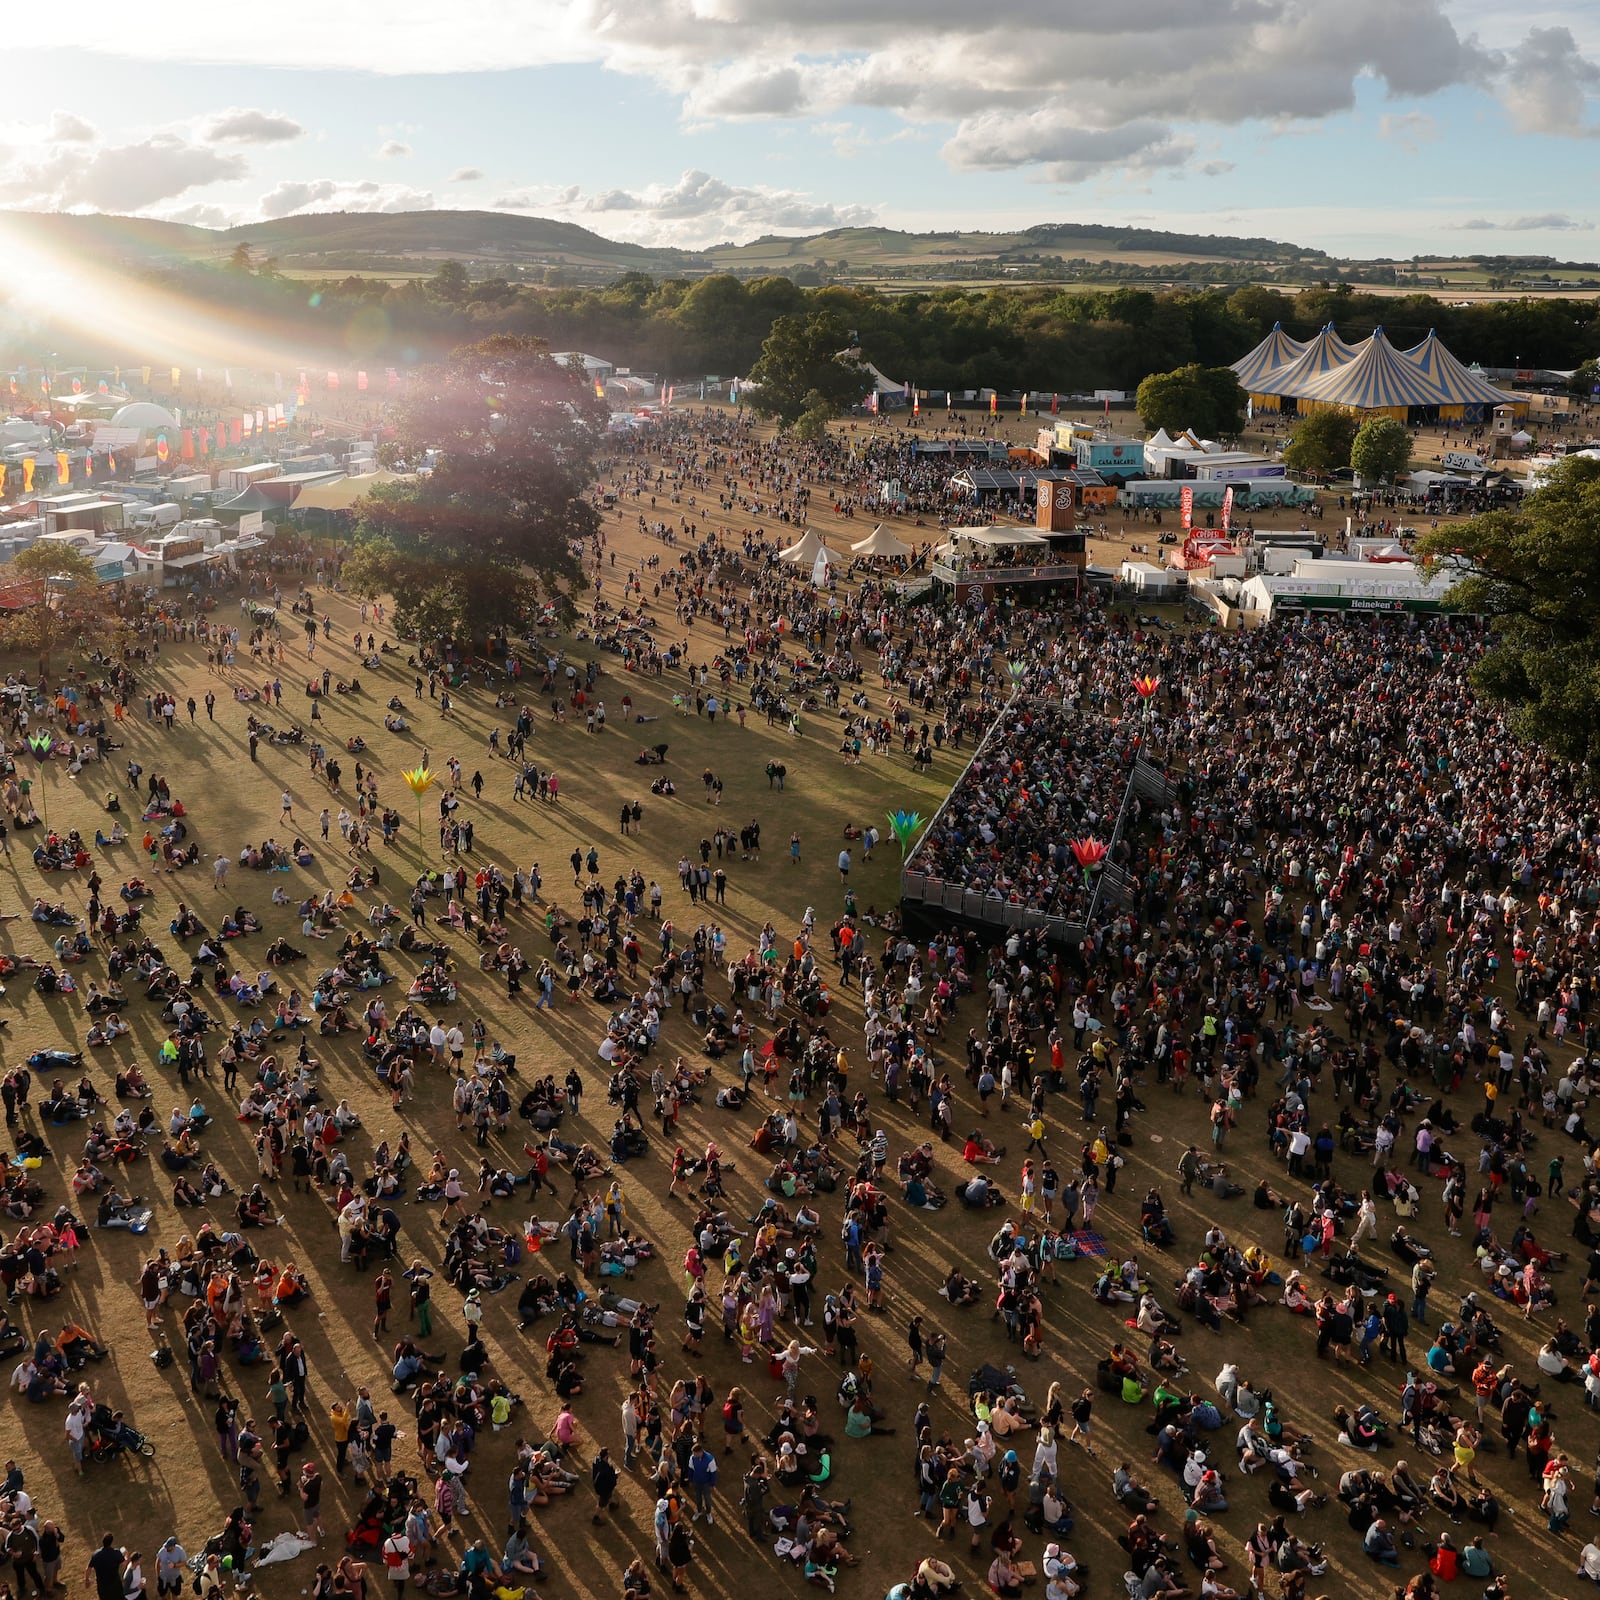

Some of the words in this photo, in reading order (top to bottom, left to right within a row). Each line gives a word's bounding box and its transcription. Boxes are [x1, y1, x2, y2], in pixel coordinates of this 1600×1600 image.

[1039, 485, 1048, 507] 3
[1056, 487, 1071, 509] 3
[1351, 600, 1390, 609] Heineken
